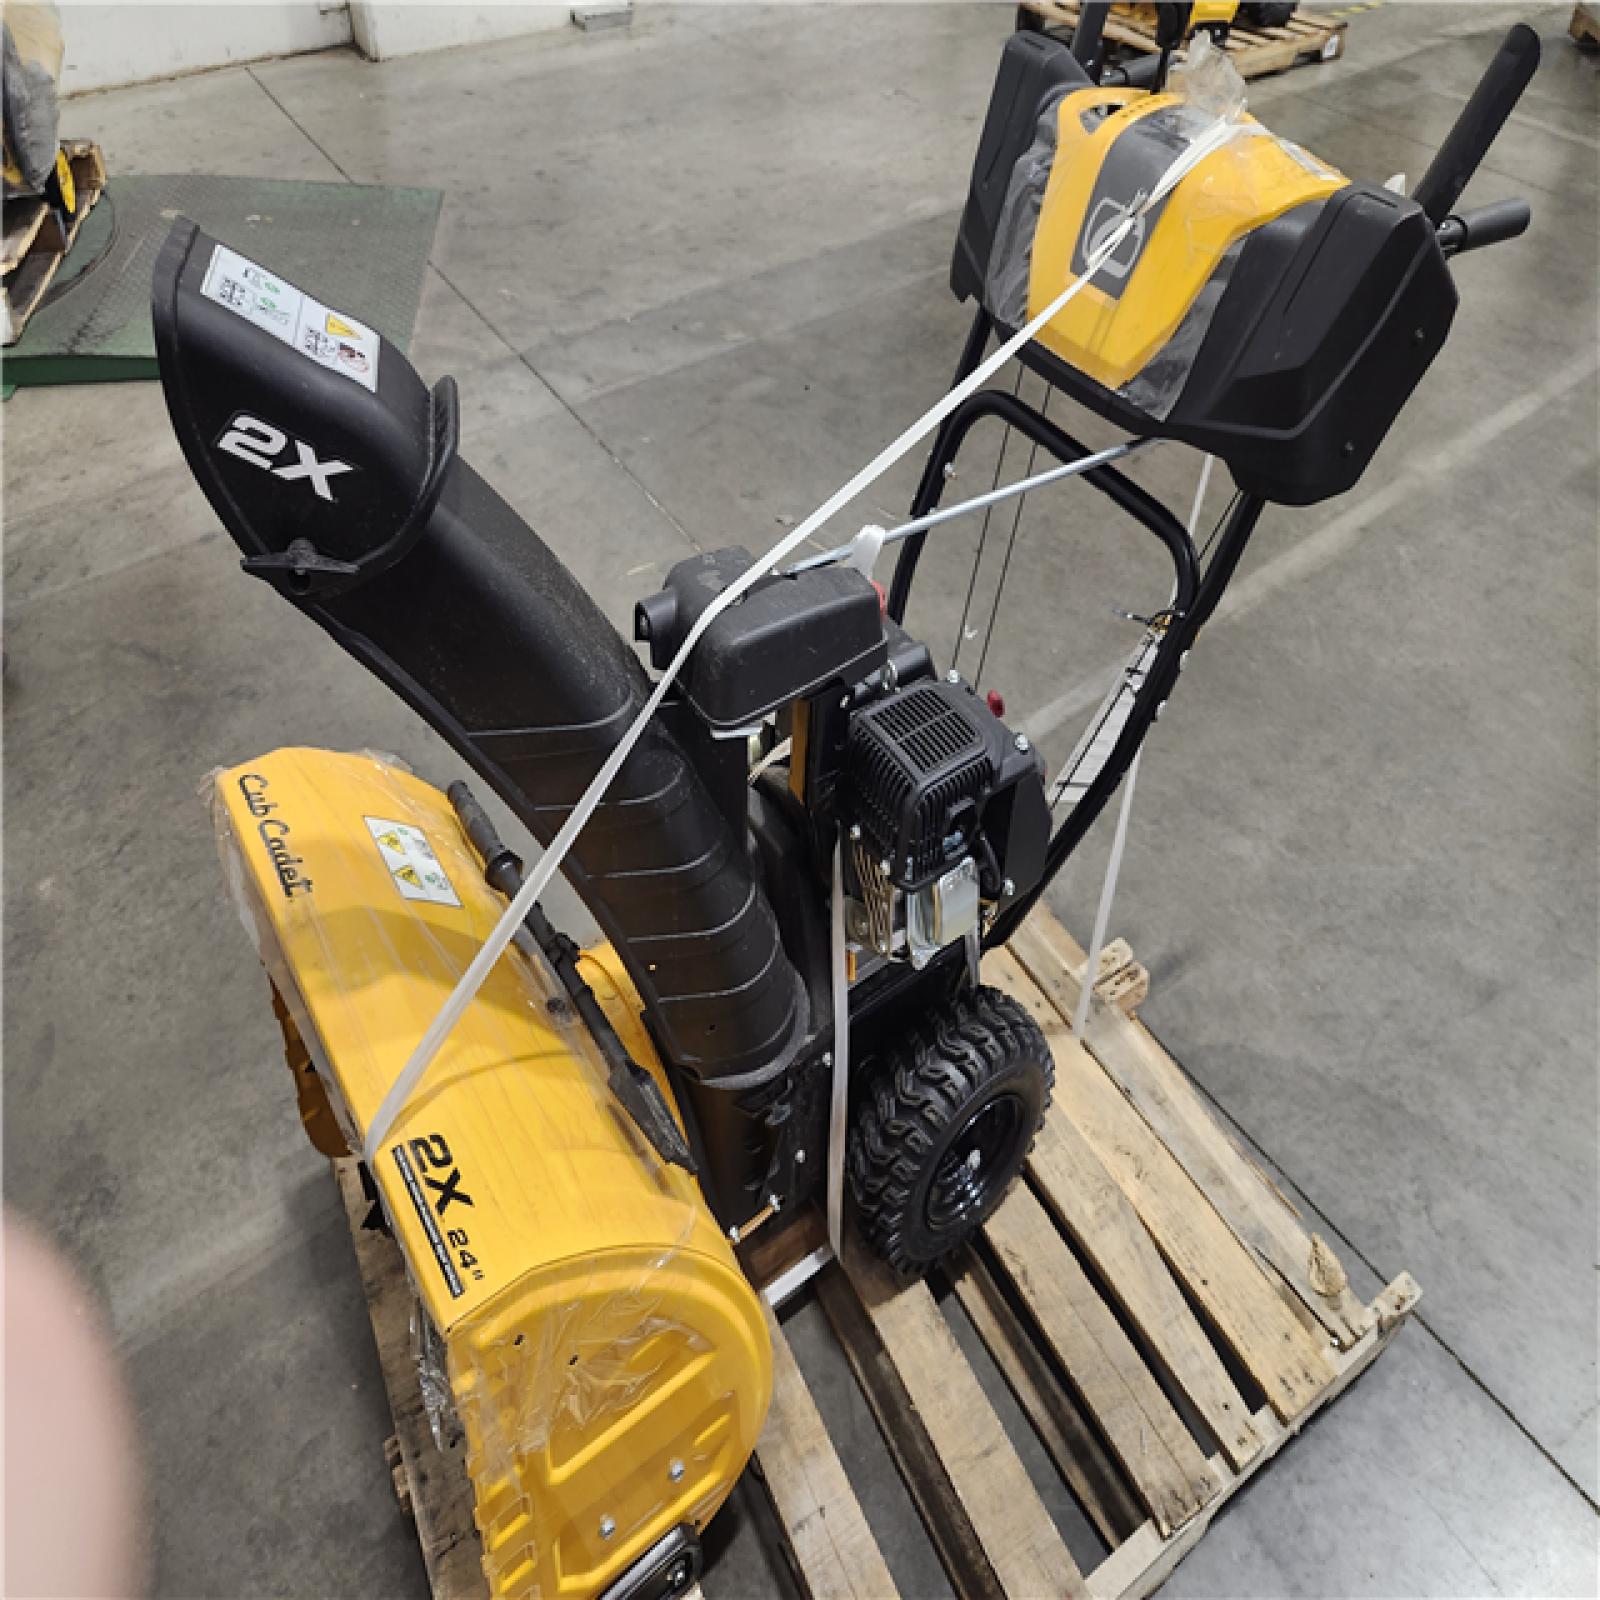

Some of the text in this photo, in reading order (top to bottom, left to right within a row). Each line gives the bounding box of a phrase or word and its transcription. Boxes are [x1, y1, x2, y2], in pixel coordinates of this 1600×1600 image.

[217, 414, 354, 502] 2X
[238, 774, 313, 898] Cub Cadet
[407, 1133, 475, 1215] 2X
[447, 1227, 485, 1281] 24"
